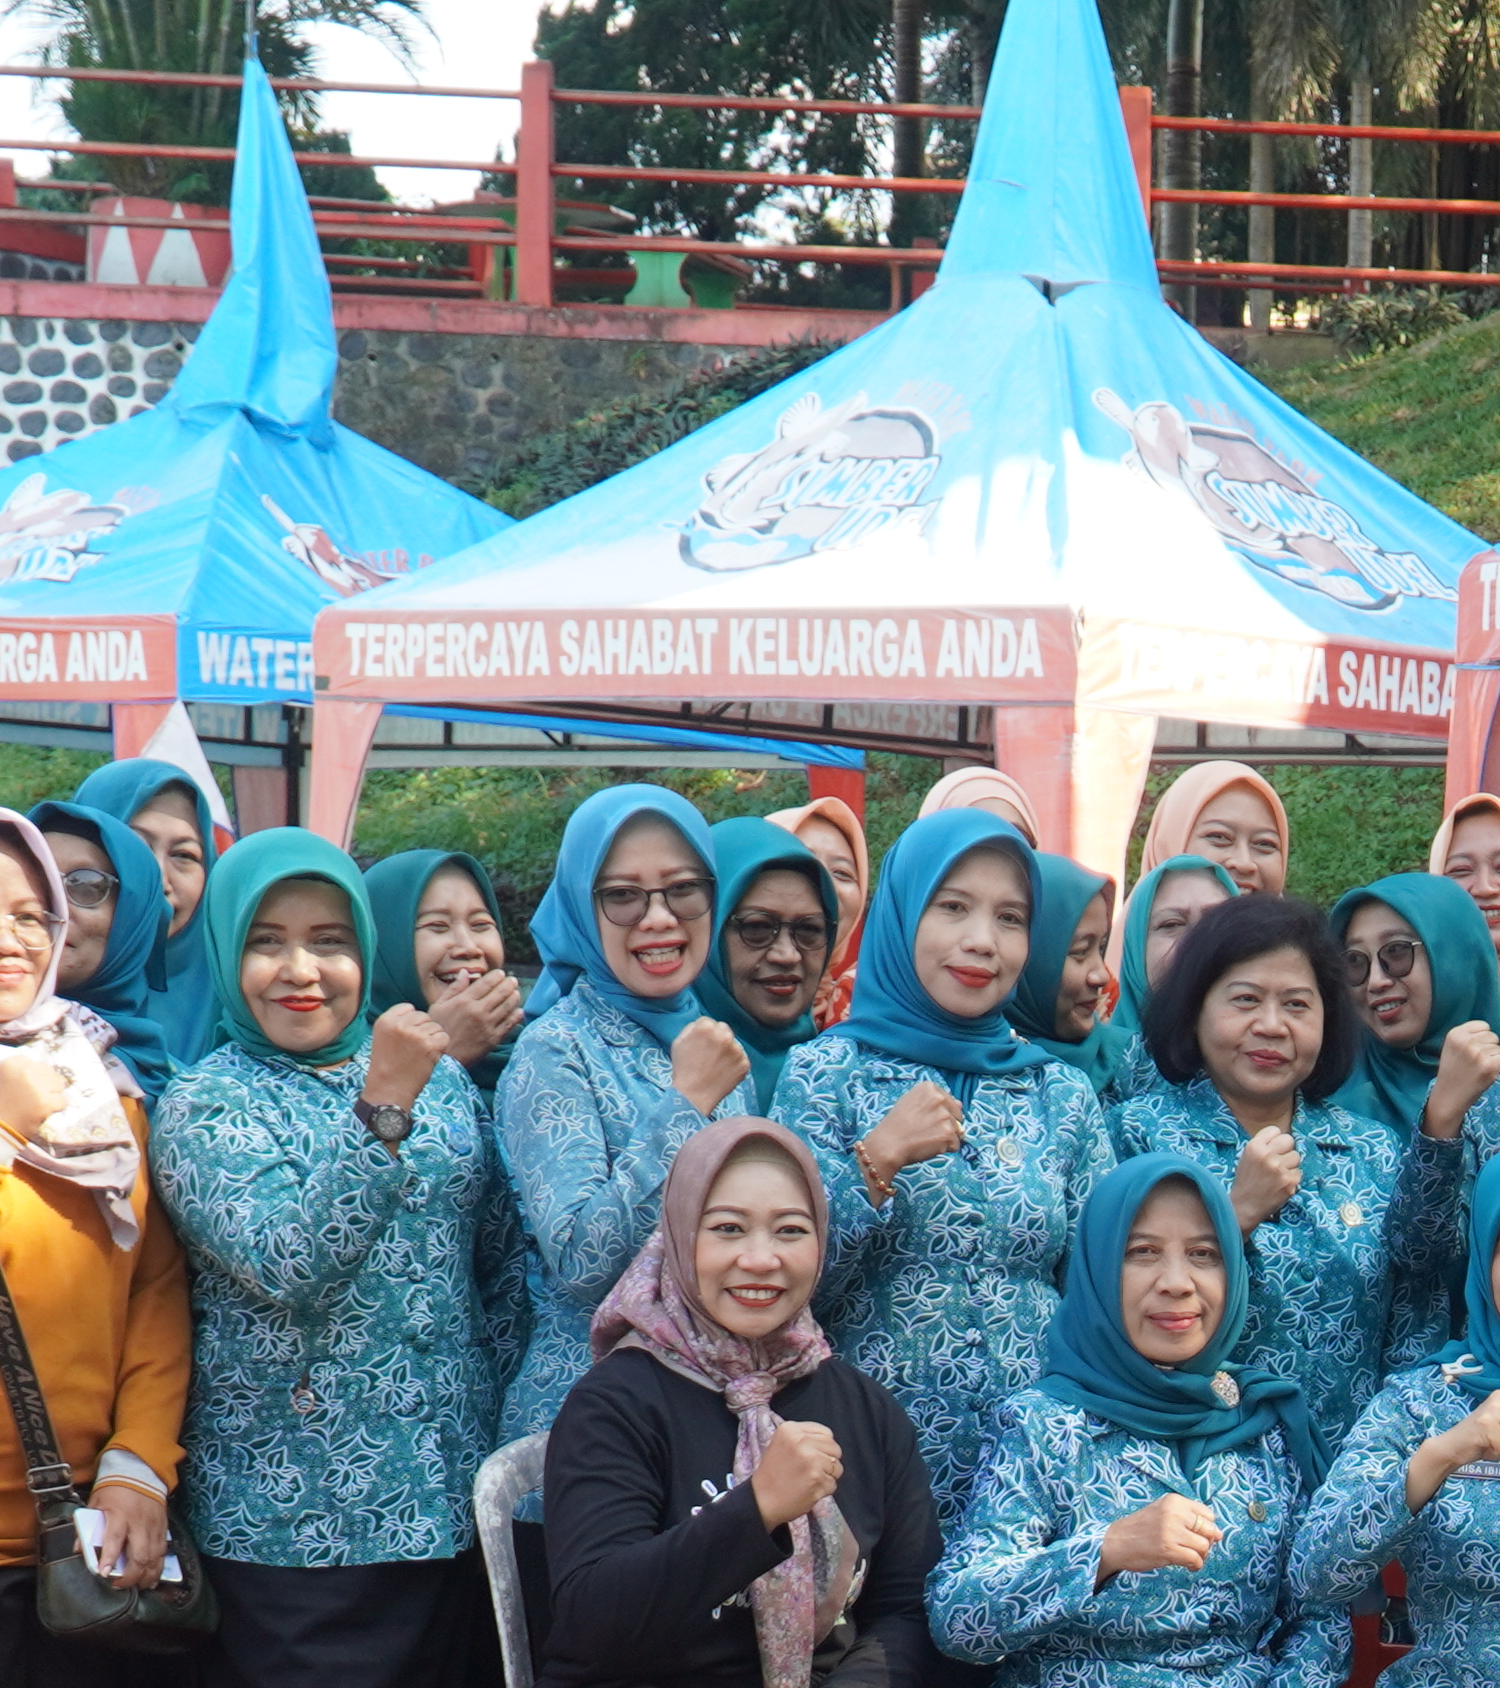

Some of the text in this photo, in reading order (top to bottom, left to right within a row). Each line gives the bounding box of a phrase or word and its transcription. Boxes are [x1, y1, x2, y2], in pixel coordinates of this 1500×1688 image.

[65, 629, 148, 683] ANDA
[344, 617, 1044, 678] TERPERCAYA SAHABAT KELUARGA ANDA
[1339, 652, 1455, 716] SAHABA
[1, 1364, 19, 1402] LOVE
[13, 1364, 35, 1383] A
[21, 1386, 49, 1446] Nice
